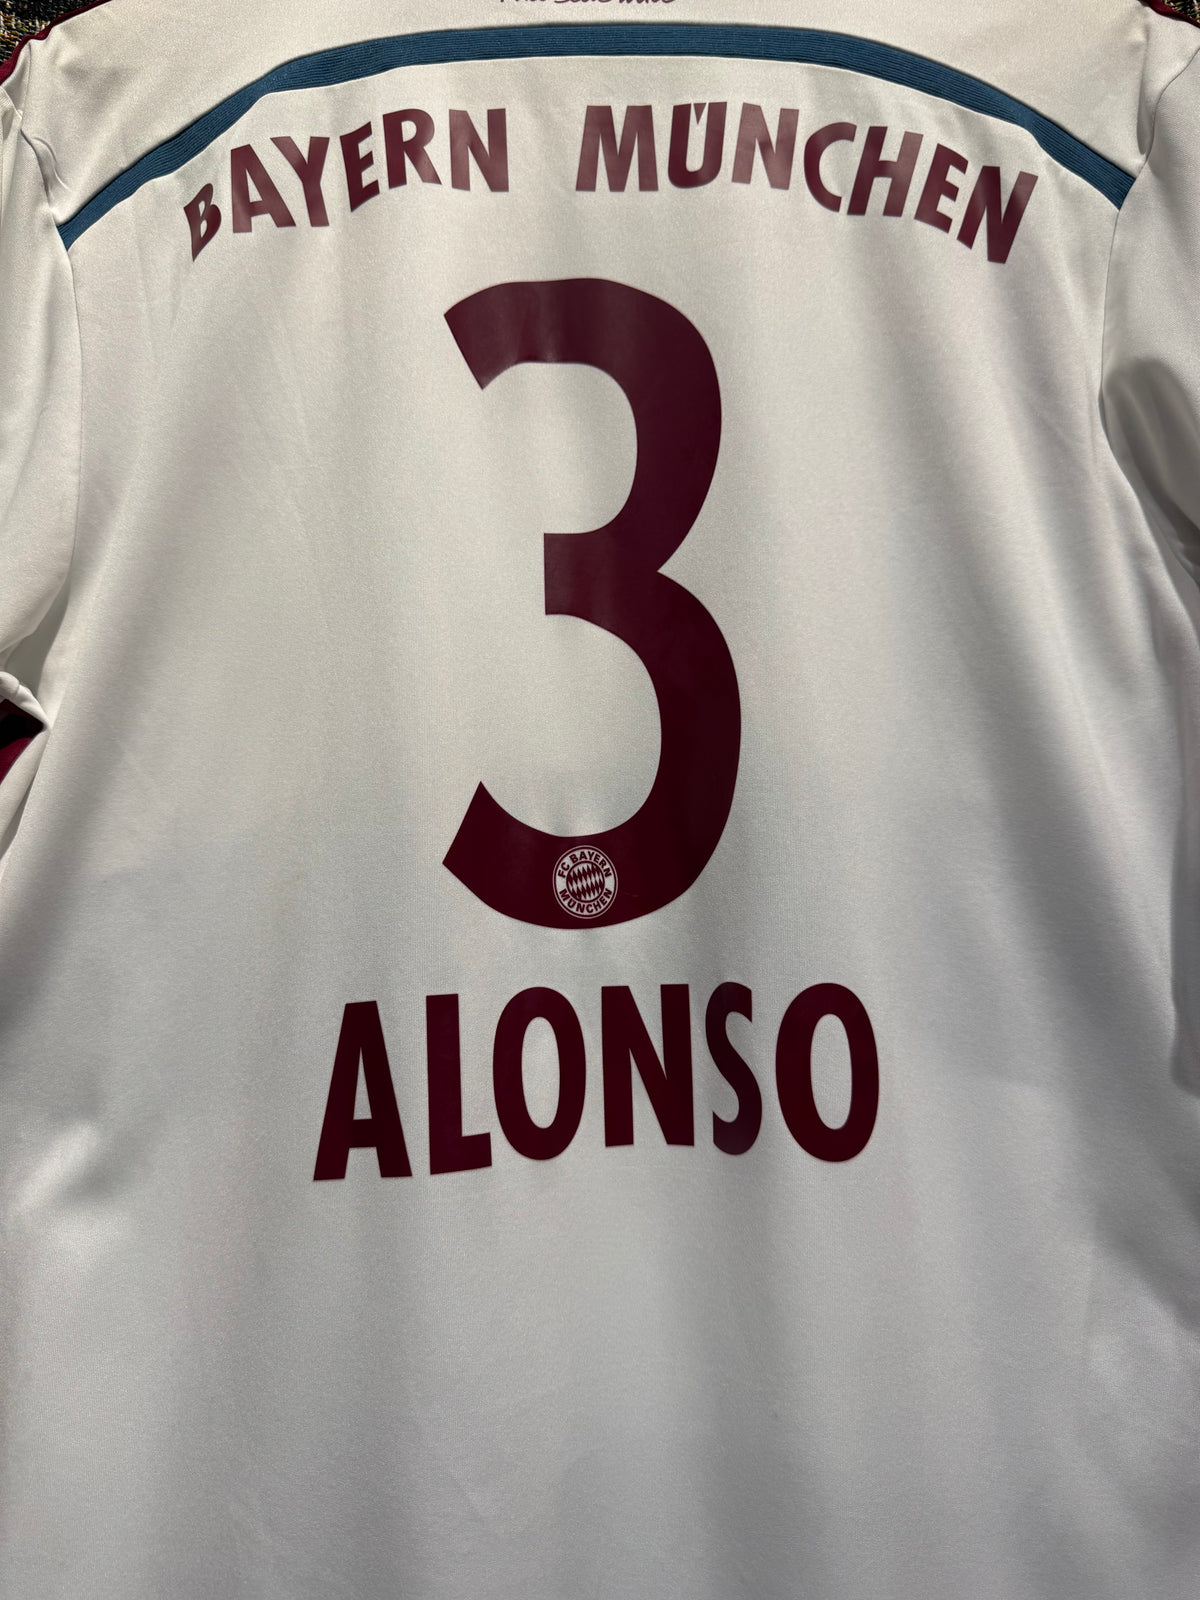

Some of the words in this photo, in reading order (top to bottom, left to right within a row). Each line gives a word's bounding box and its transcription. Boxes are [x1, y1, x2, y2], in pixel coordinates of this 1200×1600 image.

[183, 108, 509, 261] BAYERN
[576, 101, 1038, 264] MÜNCHEN
[443, 277, 742, 930] 3
[557, 861, 570, 878] FC
[568, 850, 612, 878] BAYERN
[313, 982, 880, 1182] ALONSO
